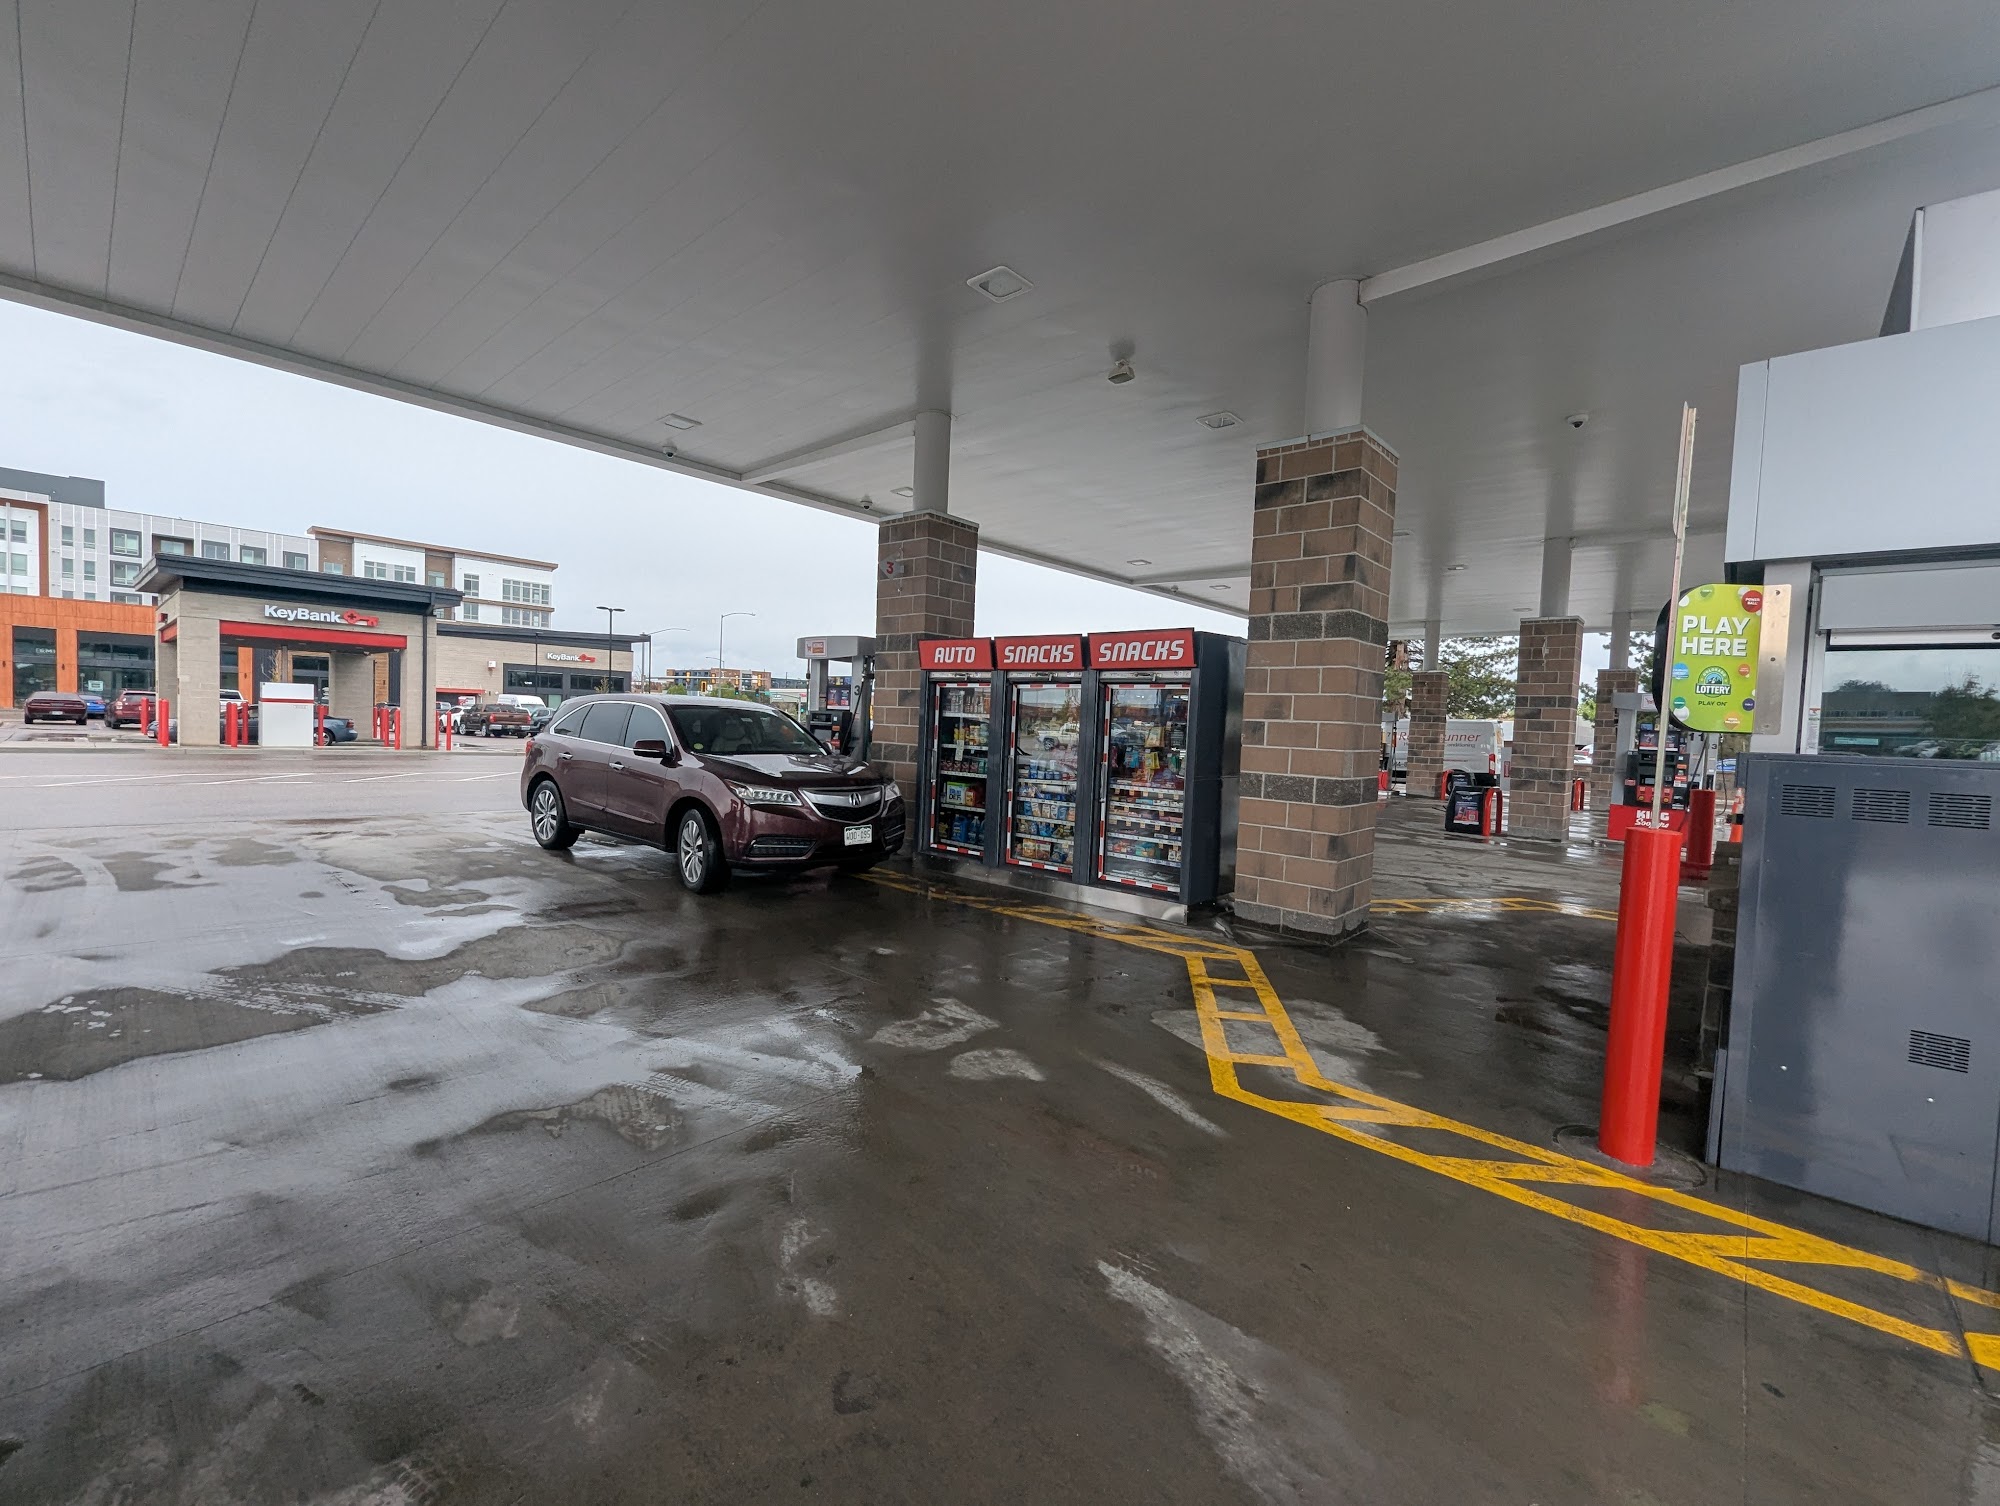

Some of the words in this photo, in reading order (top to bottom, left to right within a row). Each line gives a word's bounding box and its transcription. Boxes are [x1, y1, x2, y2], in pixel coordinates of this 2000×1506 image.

[886, 561, 894, 574] 3
[264, 605, 341, 622] KeyBank
[1682, 615, 1751, 636] PLAY
[934, 646, 976, 664] AUTO
[1004, 644, 1075, 664] SNACKS
[1099, 639, 1185, 663] SNACKS
[1680, 636, 1748, 657] HERE
[548, 652, 579, 662] KeyBank
[854, 685, 861, 696] 3
[1696, 684, 1731, 696] LOTTERY
[1636, 809, 1670, 821] KIG
